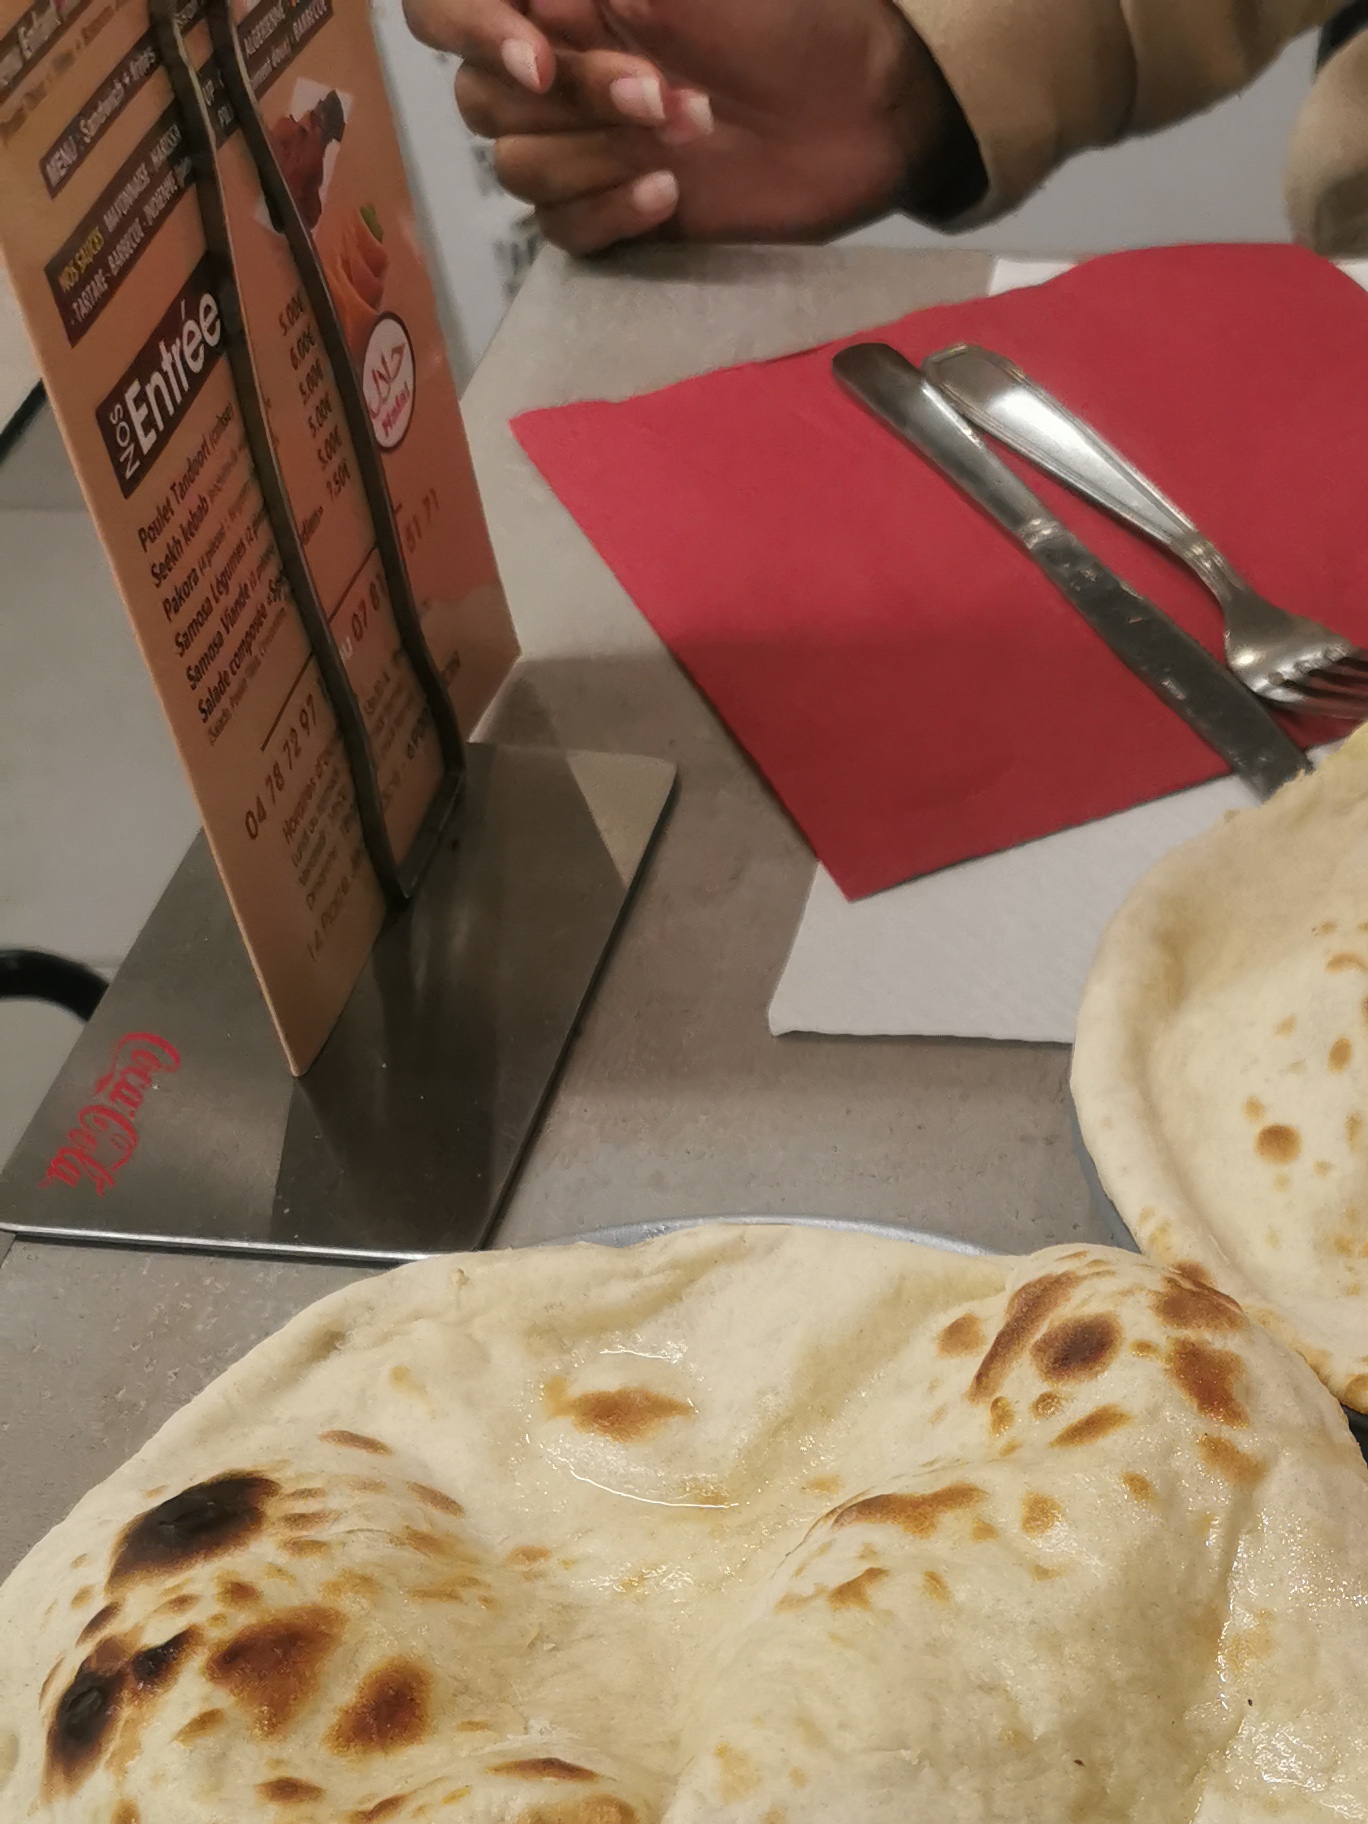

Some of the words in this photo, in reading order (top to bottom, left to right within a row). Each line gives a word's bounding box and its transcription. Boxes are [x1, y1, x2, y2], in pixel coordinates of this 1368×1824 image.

[125, 292, 222, 456] Entrée
[109, 403, 140, 480] NOS
[138, 497, 175, 552] Poulet
[169, 433, 212, 505] Tandoori
[179, 493, 210, 546] kebab
[162, 567, 200, 624] Pakora
[174, 596, 214, 658] Samosa
[186, 630, 225, 691] Samosa
[219, 581, 250, 636] Viande
[198, 669, 231, 724] Salade
[244, 796, 268, 841] 04
[37, 1031, 181, 1199] Coca-Cola
